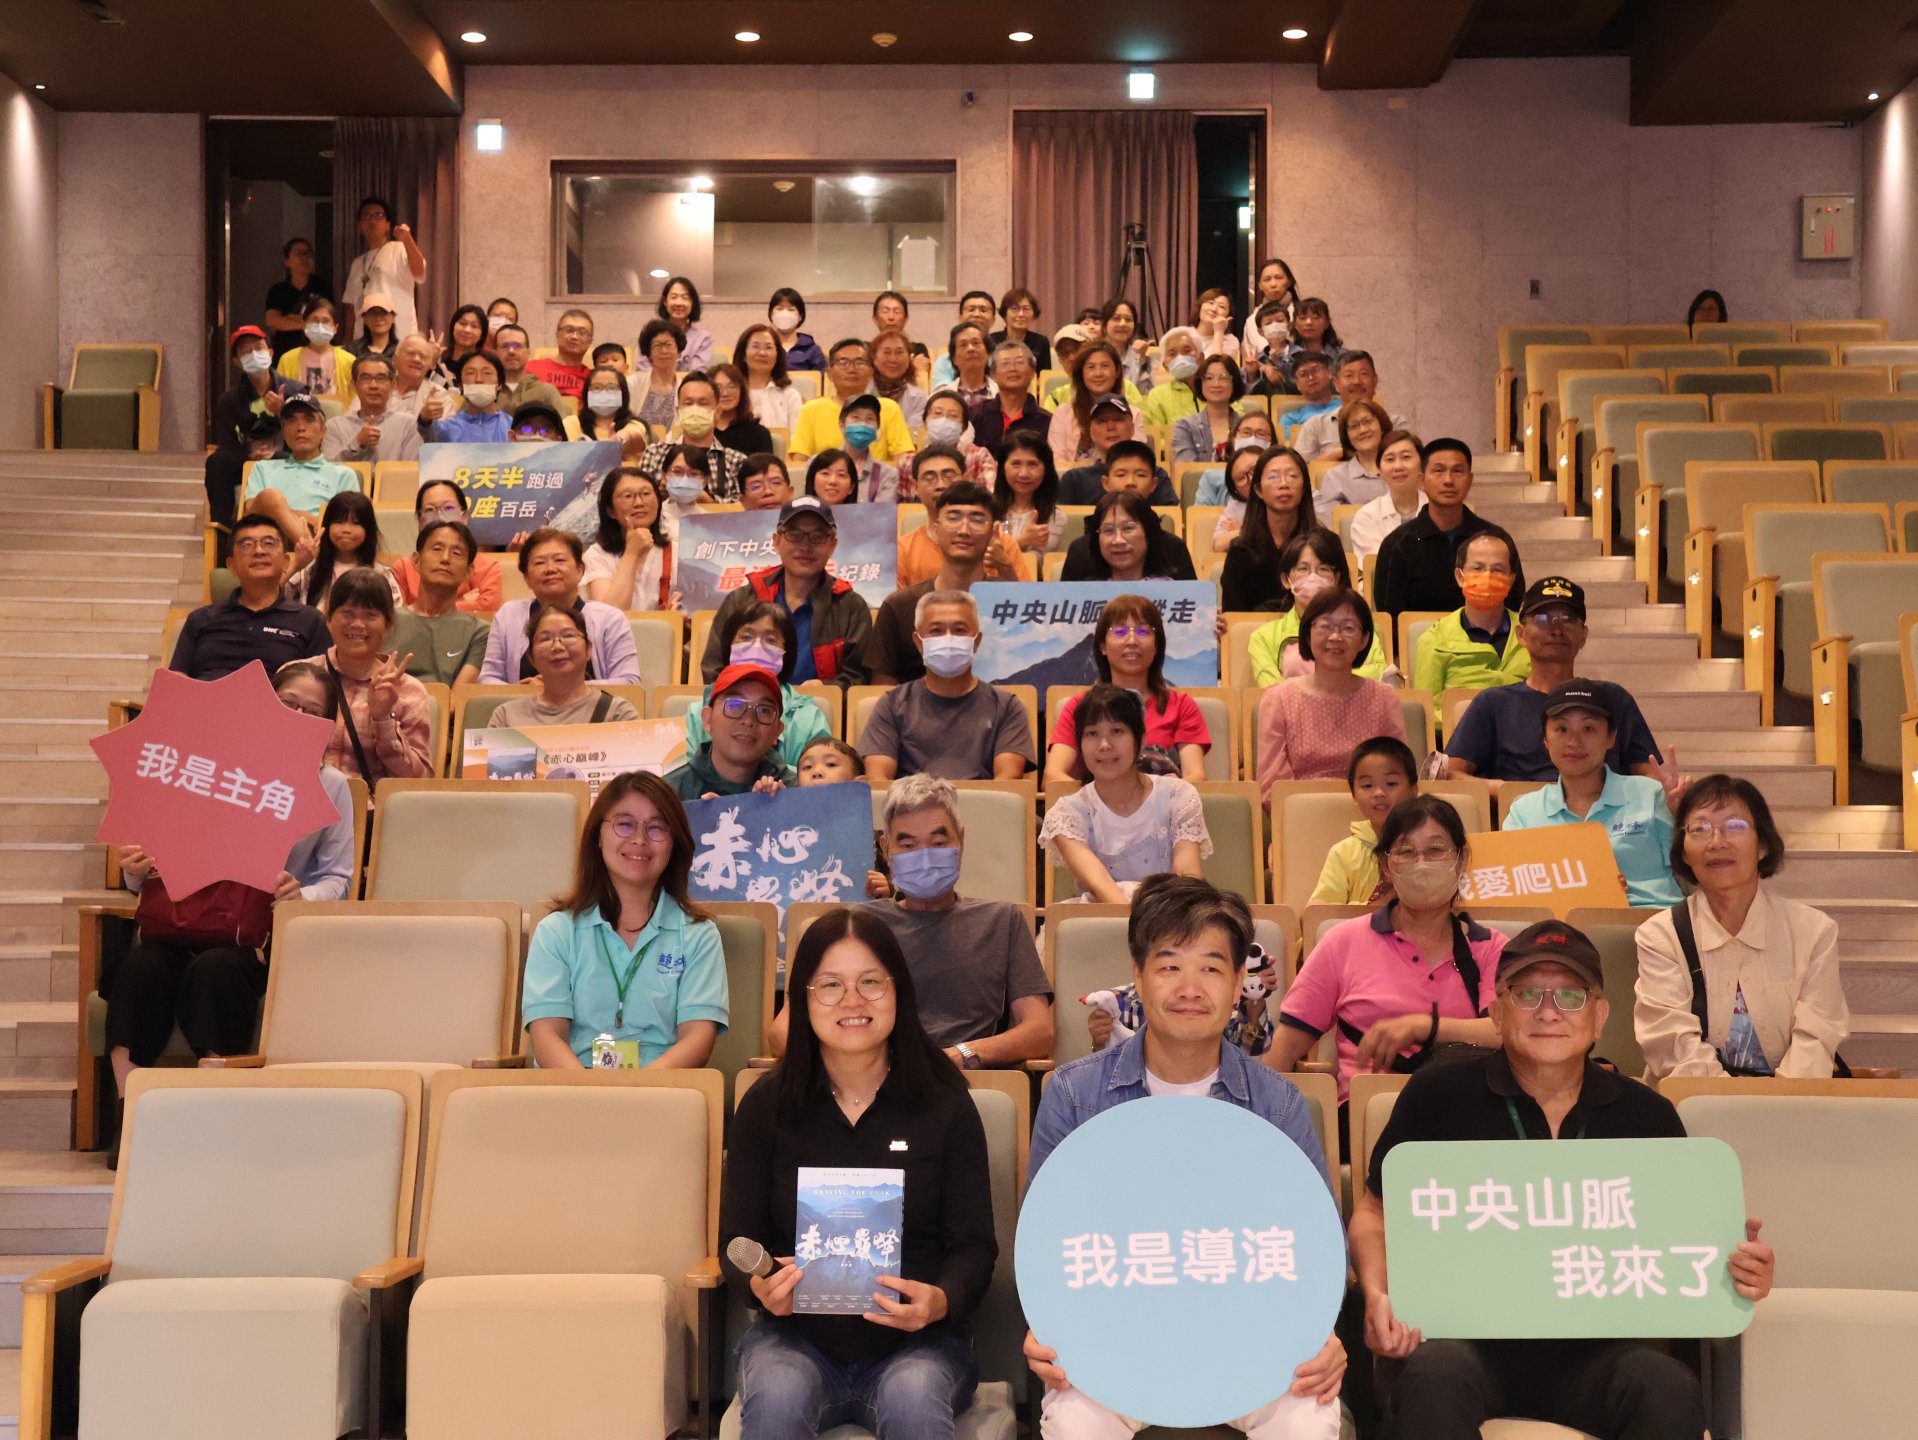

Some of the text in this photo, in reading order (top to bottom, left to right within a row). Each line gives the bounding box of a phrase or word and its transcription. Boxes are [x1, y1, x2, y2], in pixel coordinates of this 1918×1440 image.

[136, 742, 295, 821] 我是主角
[1411, 1176, 1637, 1232] 中央山脈
[1062, 1226, 1298, 1289] 我是導演
[1551, 1244, 1719, 1299] 我來了
